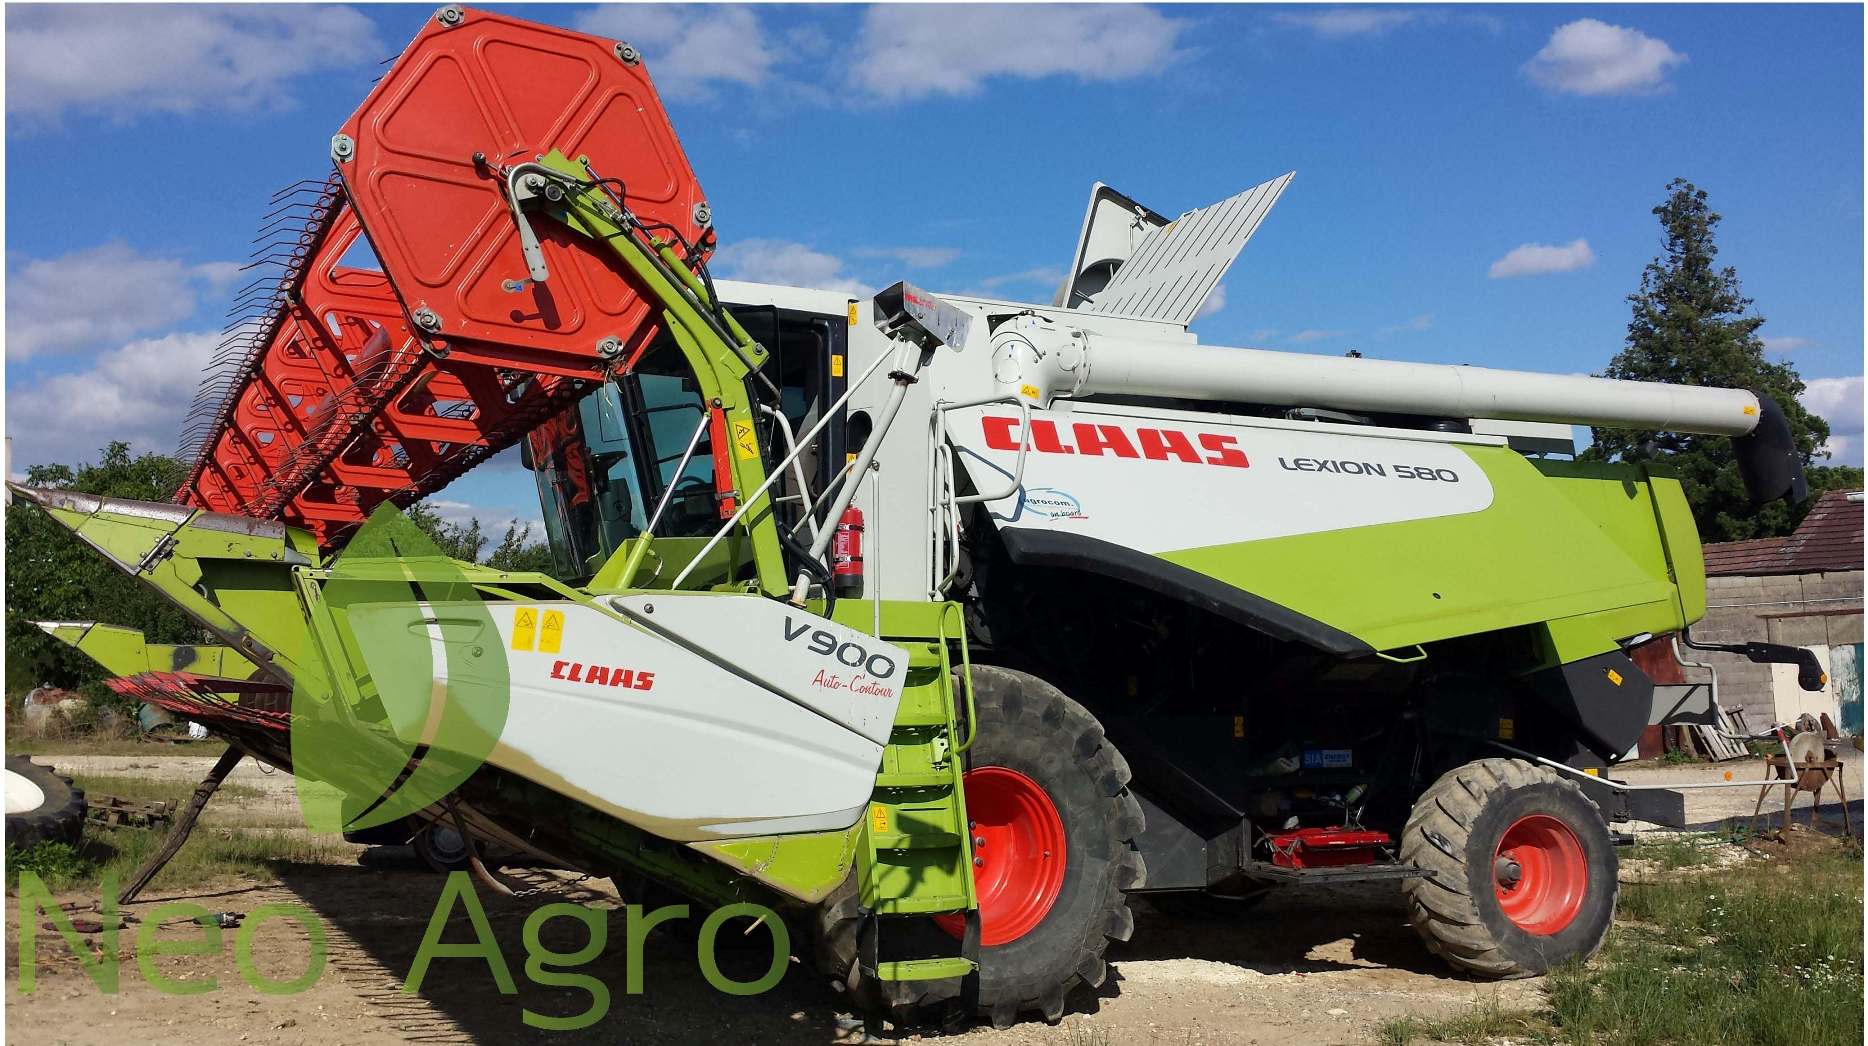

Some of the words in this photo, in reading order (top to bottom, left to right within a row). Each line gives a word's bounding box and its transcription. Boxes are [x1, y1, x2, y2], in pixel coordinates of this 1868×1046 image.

[981, 415, 1250, 469] CLAAS
[1278, 457, 1387, 478] LEXION
[1392, 464, 1459, 483] 580
[783, 615, 896, 680] V900
[550, 660, 655, 691] CLAAS
[812, 669, 894, 699] Auto-Contour
